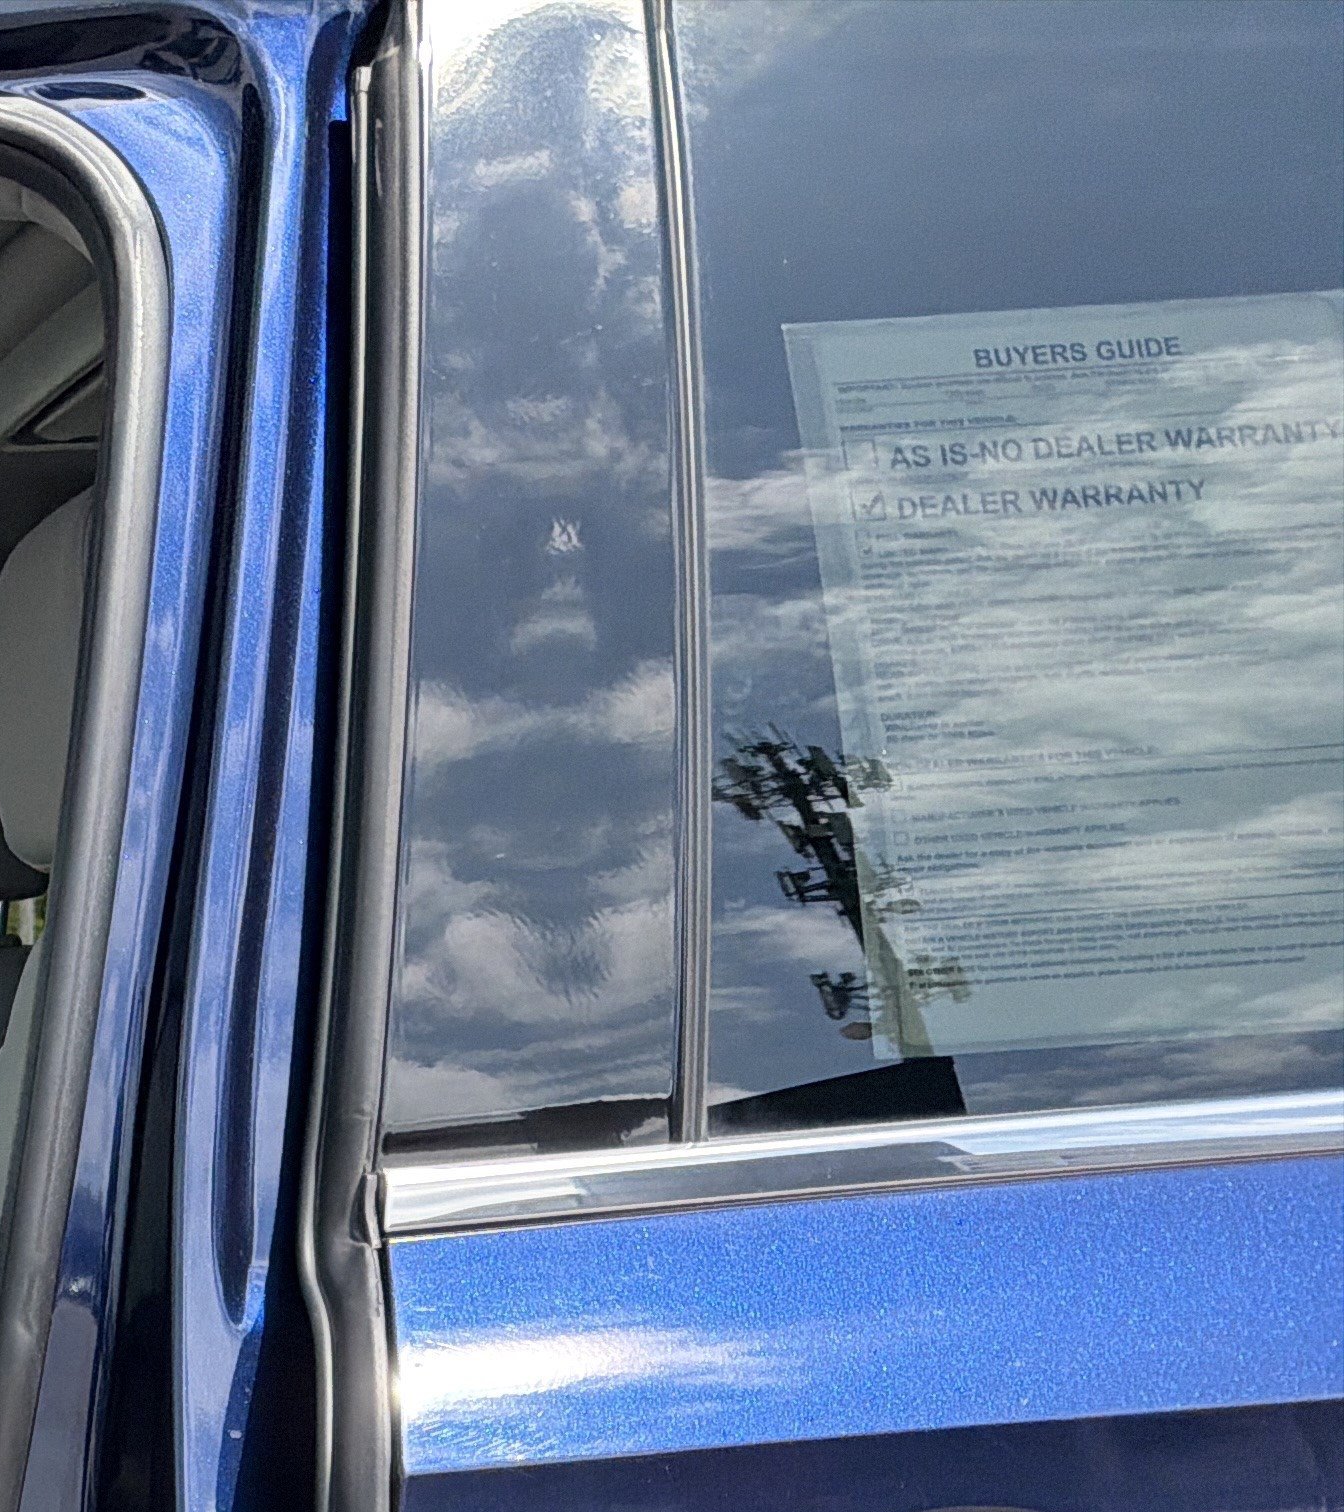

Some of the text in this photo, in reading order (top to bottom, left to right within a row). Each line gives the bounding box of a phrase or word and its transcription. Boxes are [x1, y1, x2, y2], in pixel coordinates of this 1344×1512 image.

[973, 336, 1181, 369] BUYERS GUIDE
[890, 418, 1343, 470] AS IS-NO DEALER WARRANTY
[896, 478, 1205, 520] DEALER WARRANTY
